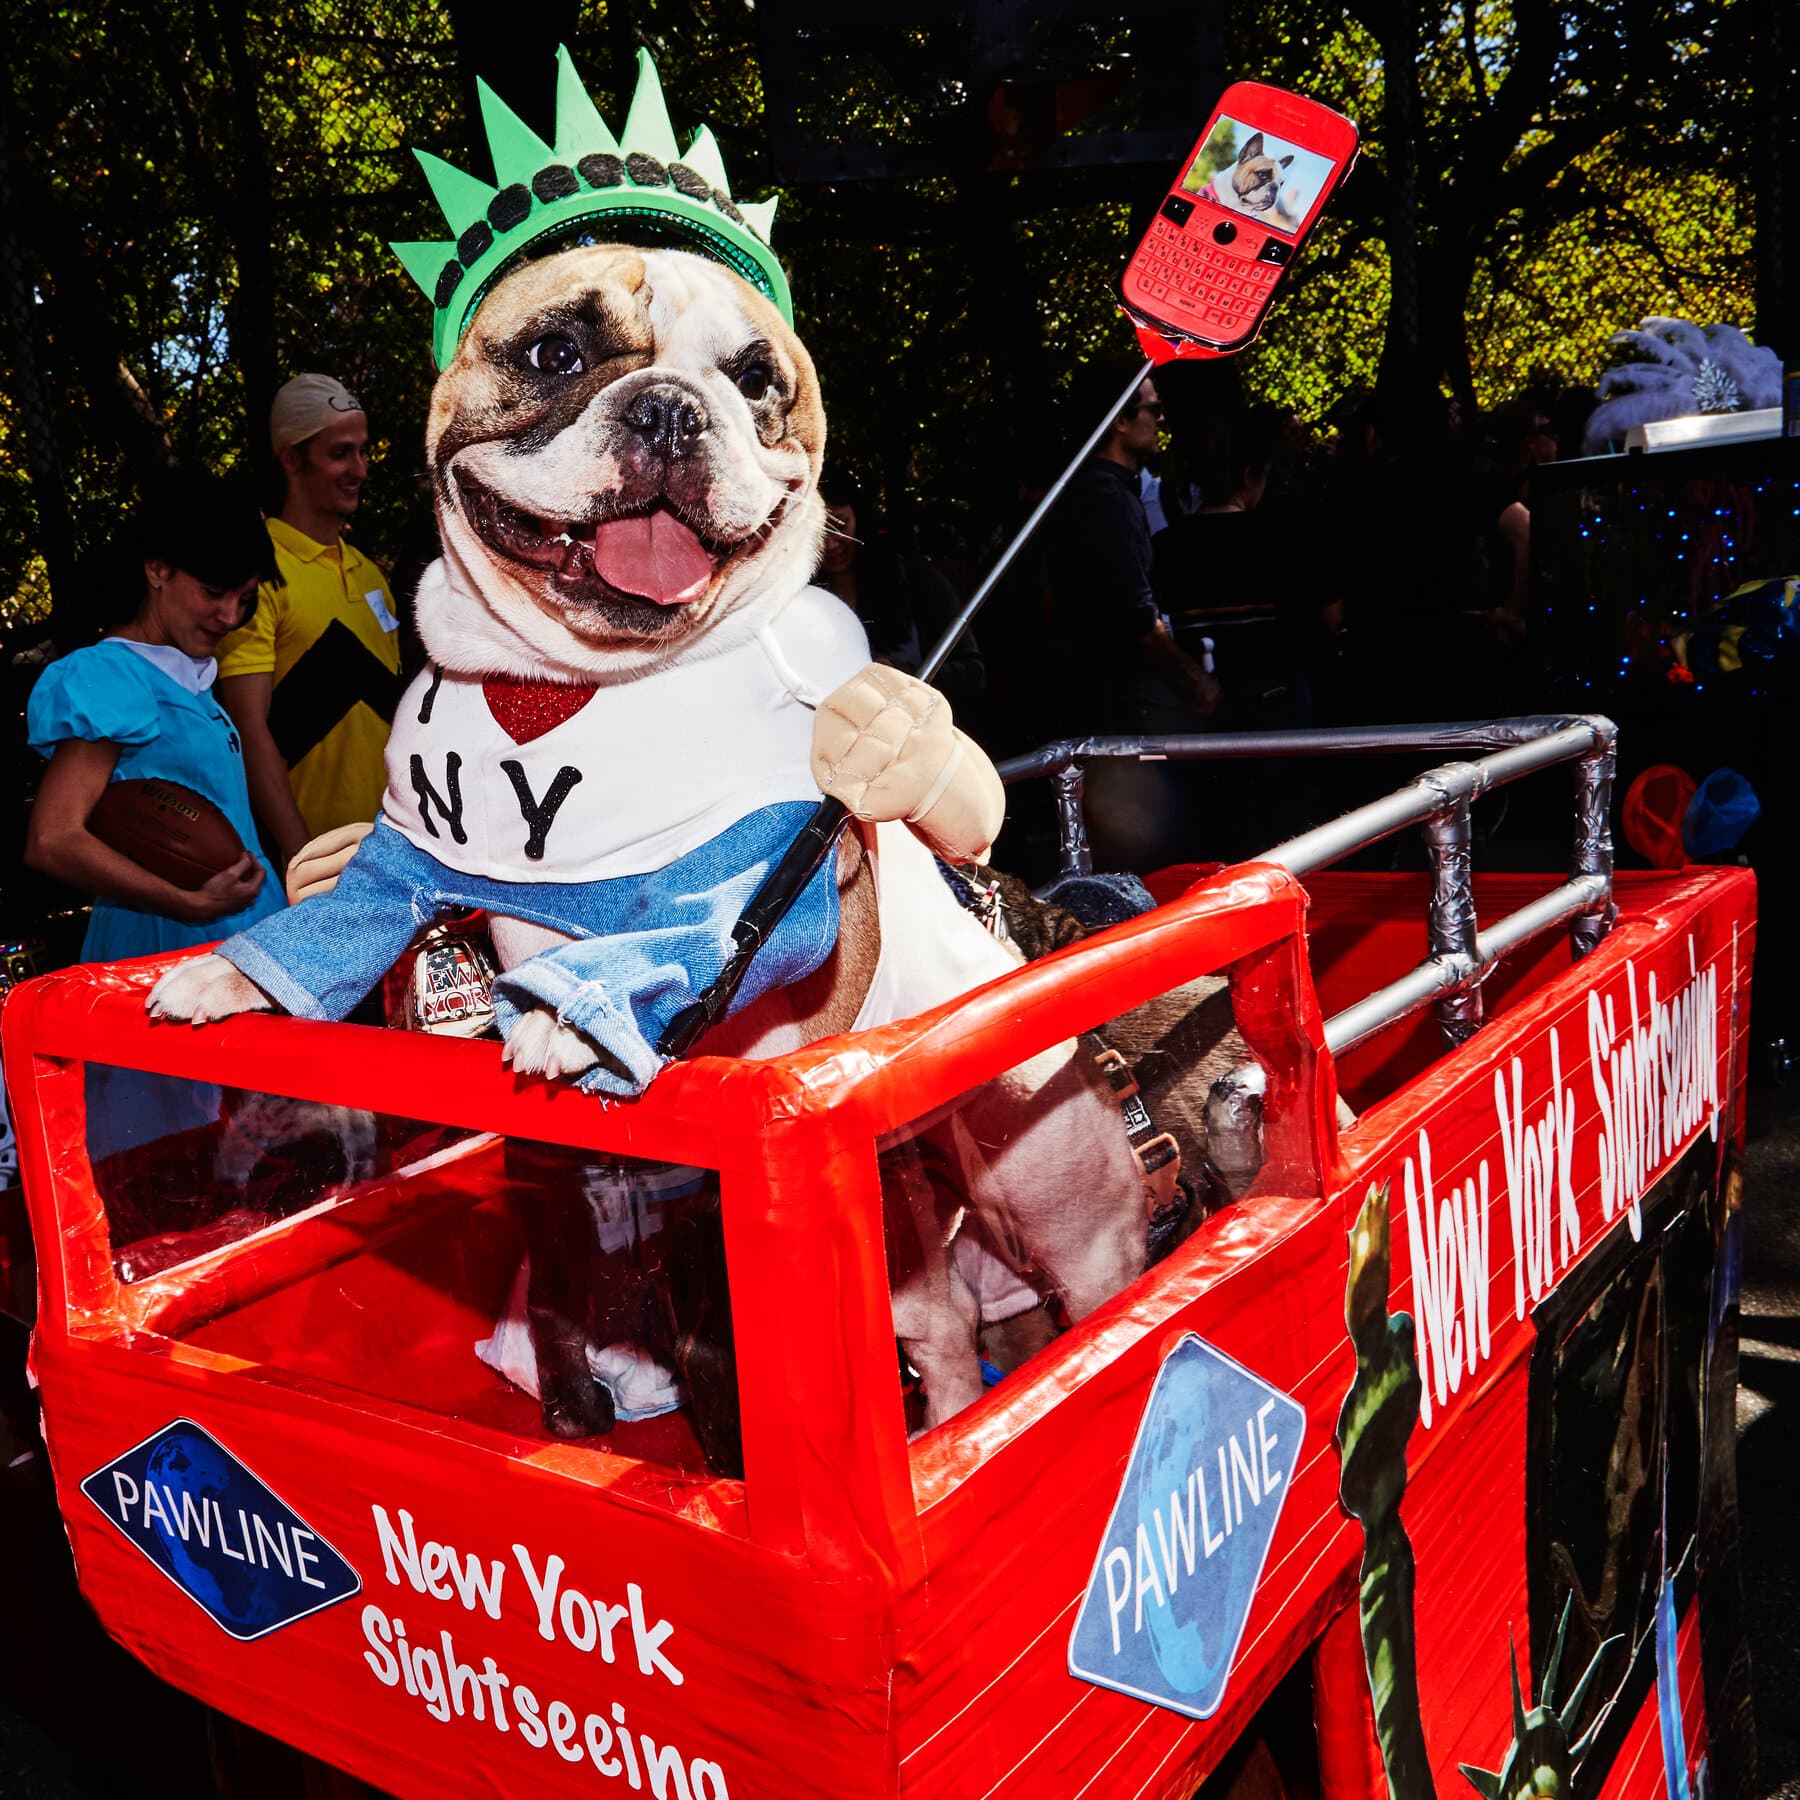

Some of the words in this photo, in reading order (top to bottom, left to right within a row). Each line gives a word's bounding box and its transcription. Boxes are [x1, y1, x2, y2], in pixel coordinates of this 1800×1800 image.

[426, 965, 480, 995] EW
[426, 986, 491, 1018] YOR
[1404, 1128, 1490, 1429] New
[1494, 1027, 1581, 1322] York
[1588, 933, 1719, 1243] Sightseeing
[112, 1470, 327, 1590] PAWLINE
[371, 1504, 506, 1620] New
[512, 1543, 684, 1686] York
[1103, 1397, 1283, 1656] PAWLINE
